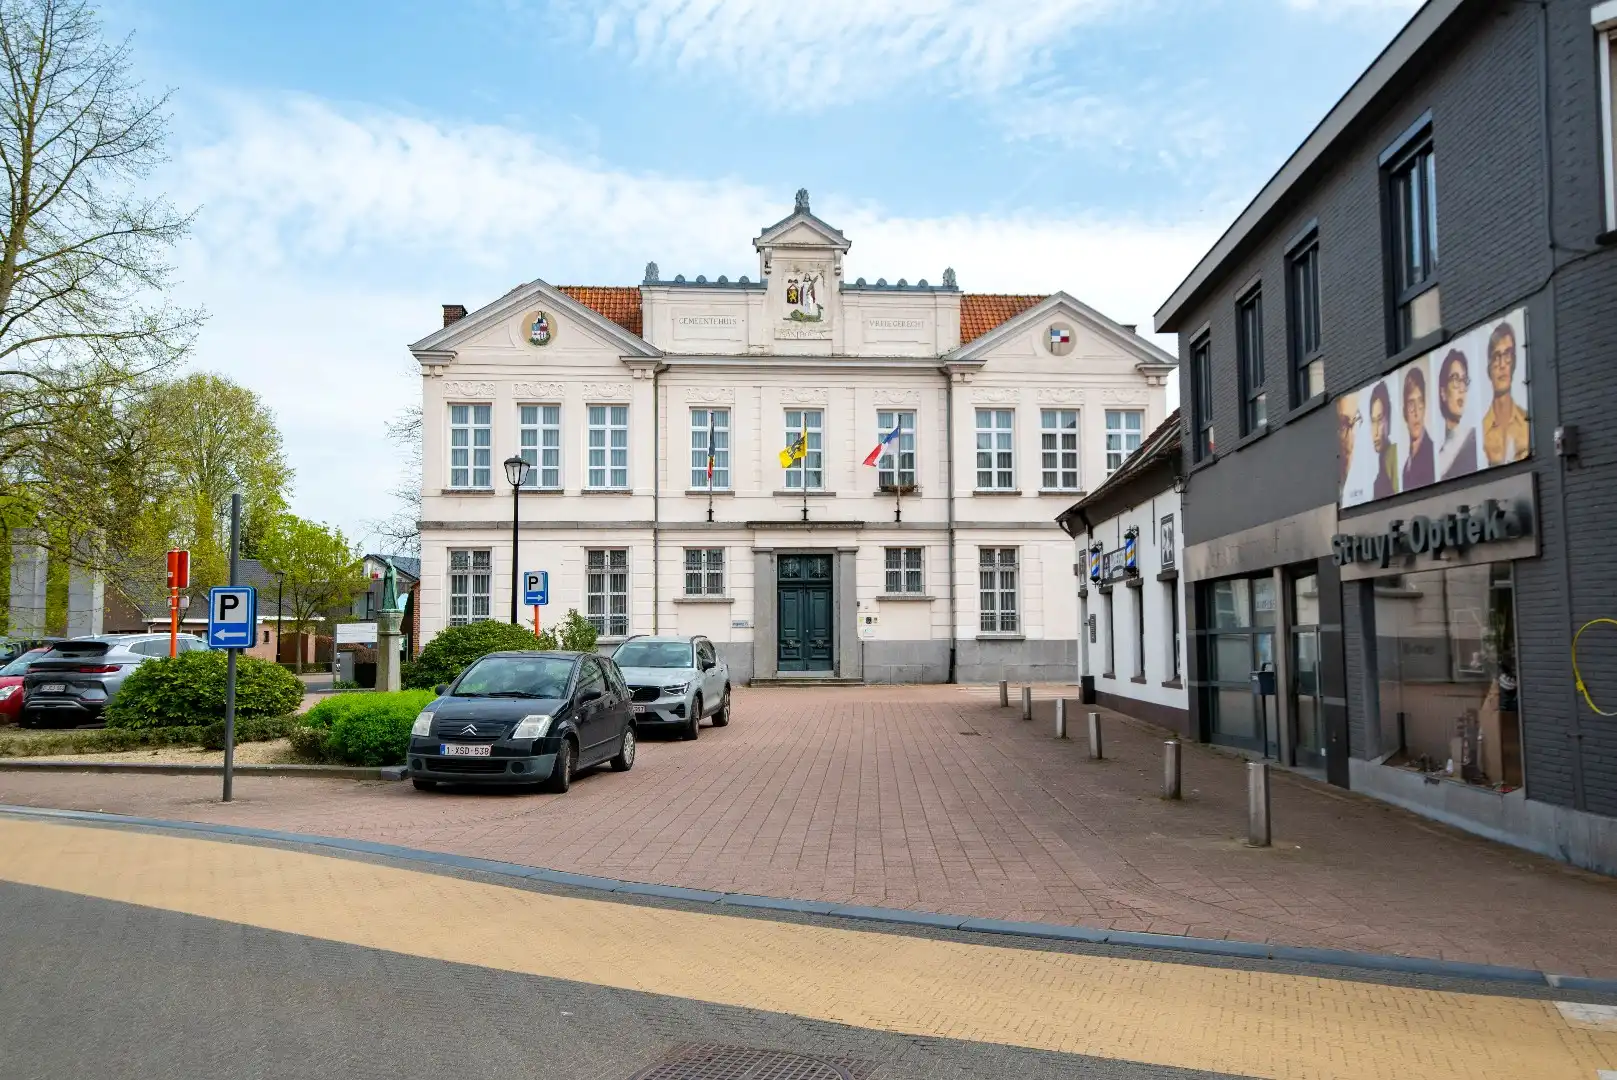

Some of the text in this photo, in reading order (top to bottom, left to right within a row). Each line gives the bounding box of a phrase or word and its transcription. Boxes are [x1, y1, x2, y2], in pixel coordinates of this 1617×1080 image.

[678, 317, 737, 325] GEMEENTEHUIS
[1409, 499, 1503, 557] Optiek
[528, 576, 539, 591] P
[220, 594, 239, 620] P
